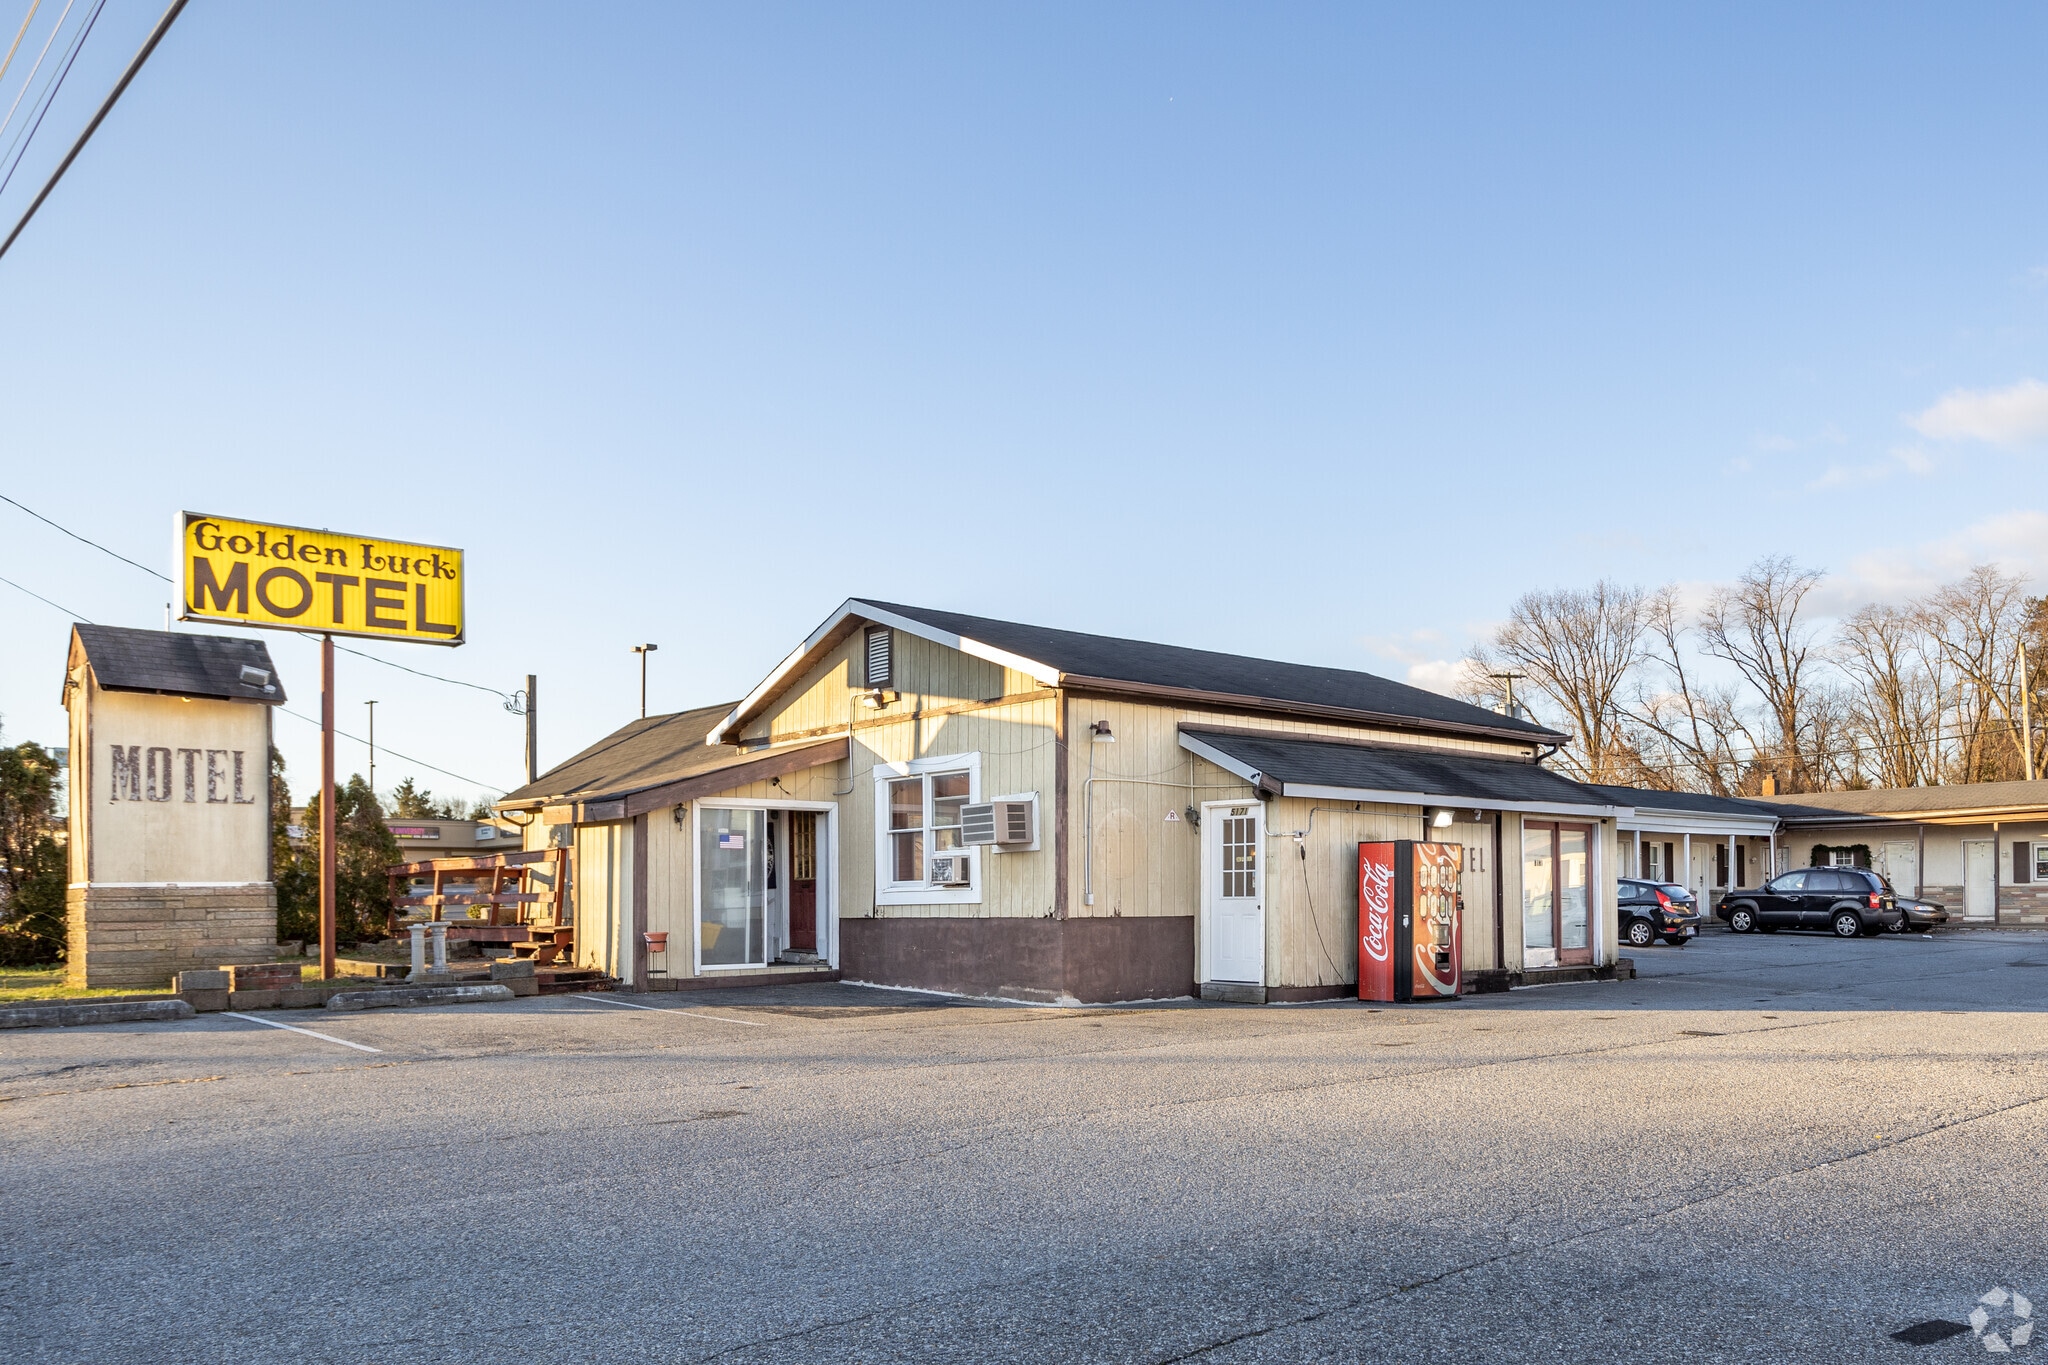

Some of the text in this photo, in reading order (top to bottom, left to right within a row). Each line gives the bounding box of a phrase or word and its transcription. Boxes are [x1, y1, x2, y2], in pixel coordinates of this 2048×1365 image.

[194, 522, 456, 580] Golden Luck
[193, 555, 457, 635] MOTEL
[109, 744, 256, 805] MOTEL
[1230, 807, 1248, 816] 5171
